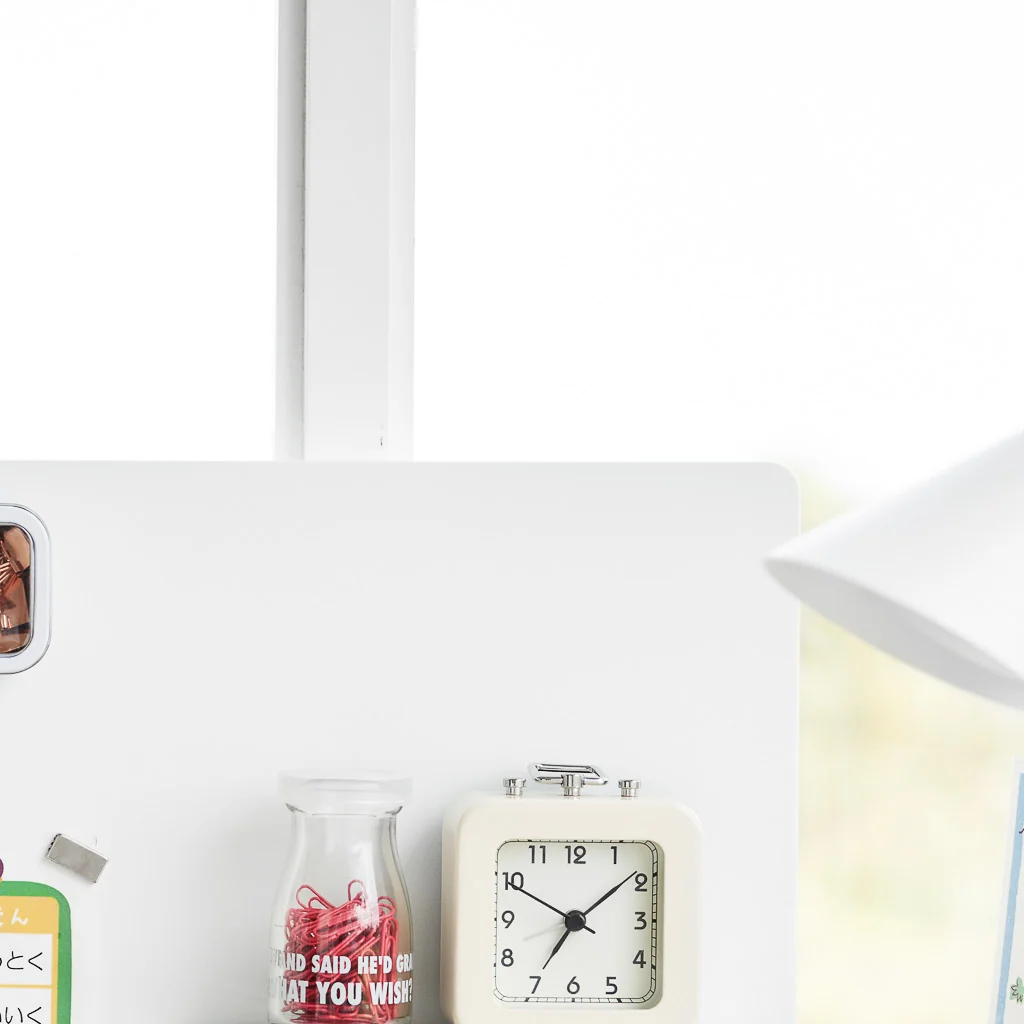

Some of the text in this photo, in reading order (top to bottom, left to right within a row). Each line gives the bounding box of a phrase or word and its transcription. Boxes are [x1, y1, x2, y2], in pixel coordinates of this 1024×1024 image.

[528, 845, 547, 864] 11
[564, 845, 587, 865] 12
[610, 845, 618, 865] 1
[502, 871, 525, 891] 10
[634, 872, 648, 892] 2
[501, 910, 515, 929] 9
[634, 911, 648, 930] 3
[311, 954, 351, 975] SAID
[357, 955, 393, 975] HE'D
[500, 948, 515, 967] 8
[632, 949, 647, 969] 4
[315, 981, 362, 1006] YOU
[370, 977, 413, 1006] WISH?
[529, 975, 542, 995] 7
[566, 976, 581, 995] 6
[605, 976, 618, 995] 5
